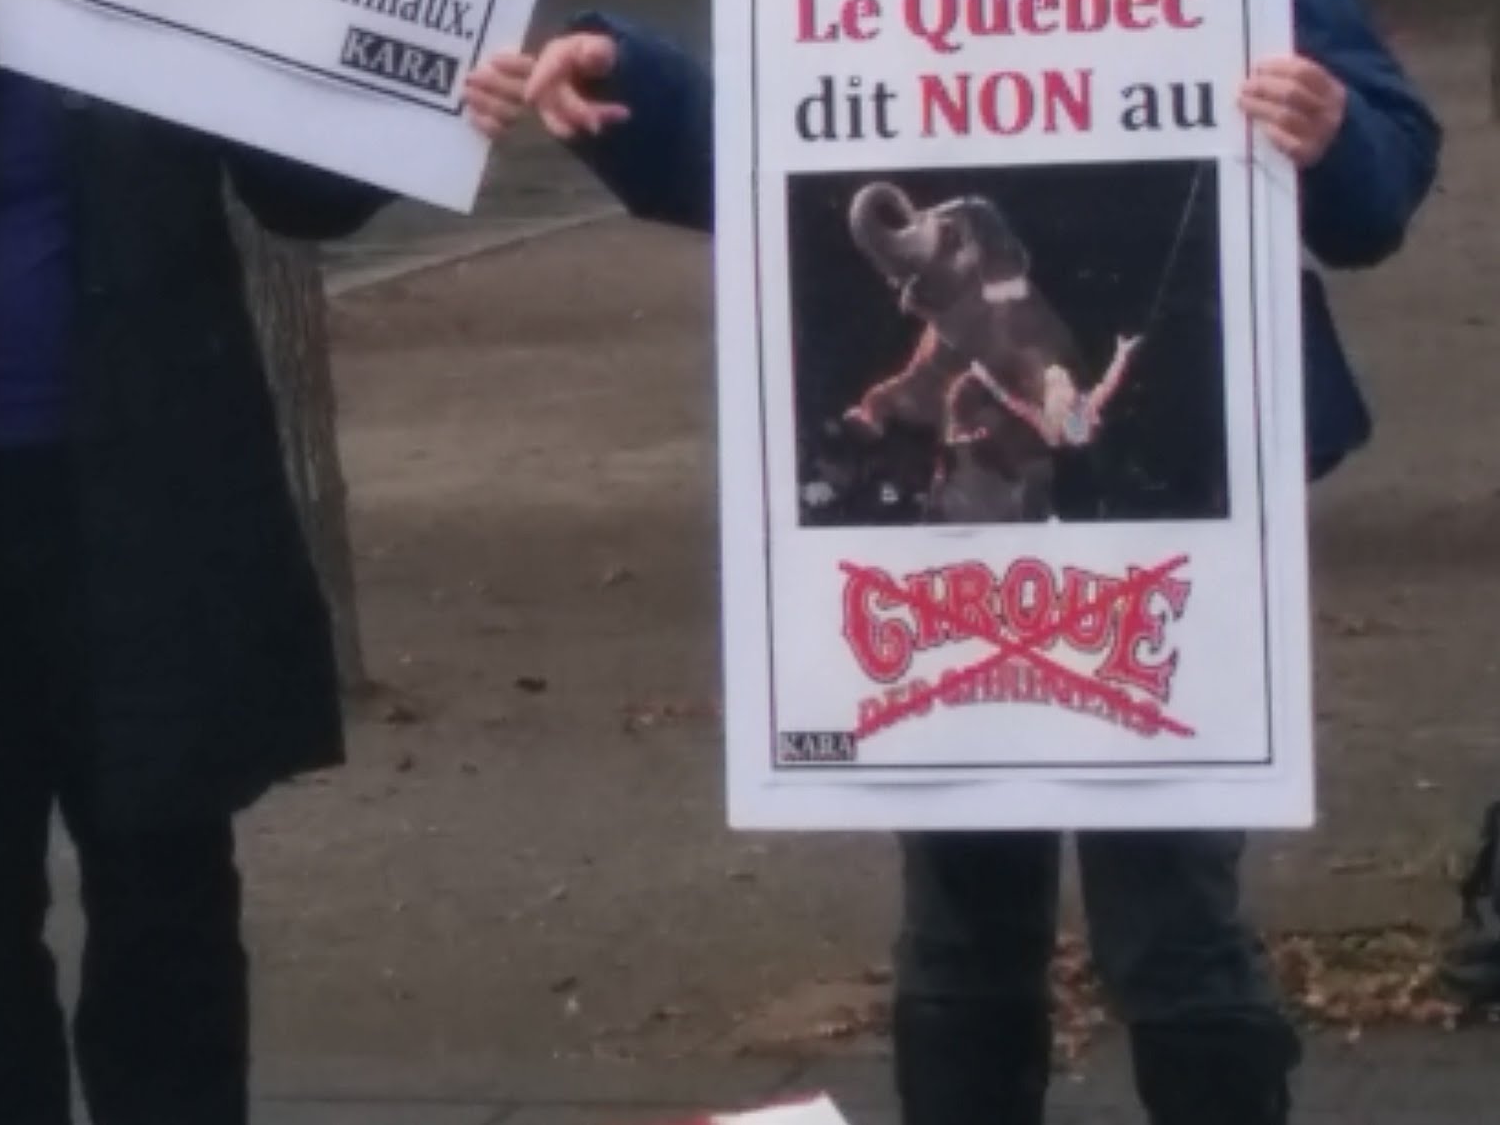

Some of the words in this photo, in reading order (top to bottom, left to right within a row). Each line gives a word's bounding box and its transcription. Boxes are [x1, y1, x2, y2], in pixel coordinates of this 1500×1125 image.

[344, 28, 456, 91] KARA
[794, 75, 899, 142] dit
[918, 69, 1093, 137] NON
[1119, 81, 1218, 132] au
